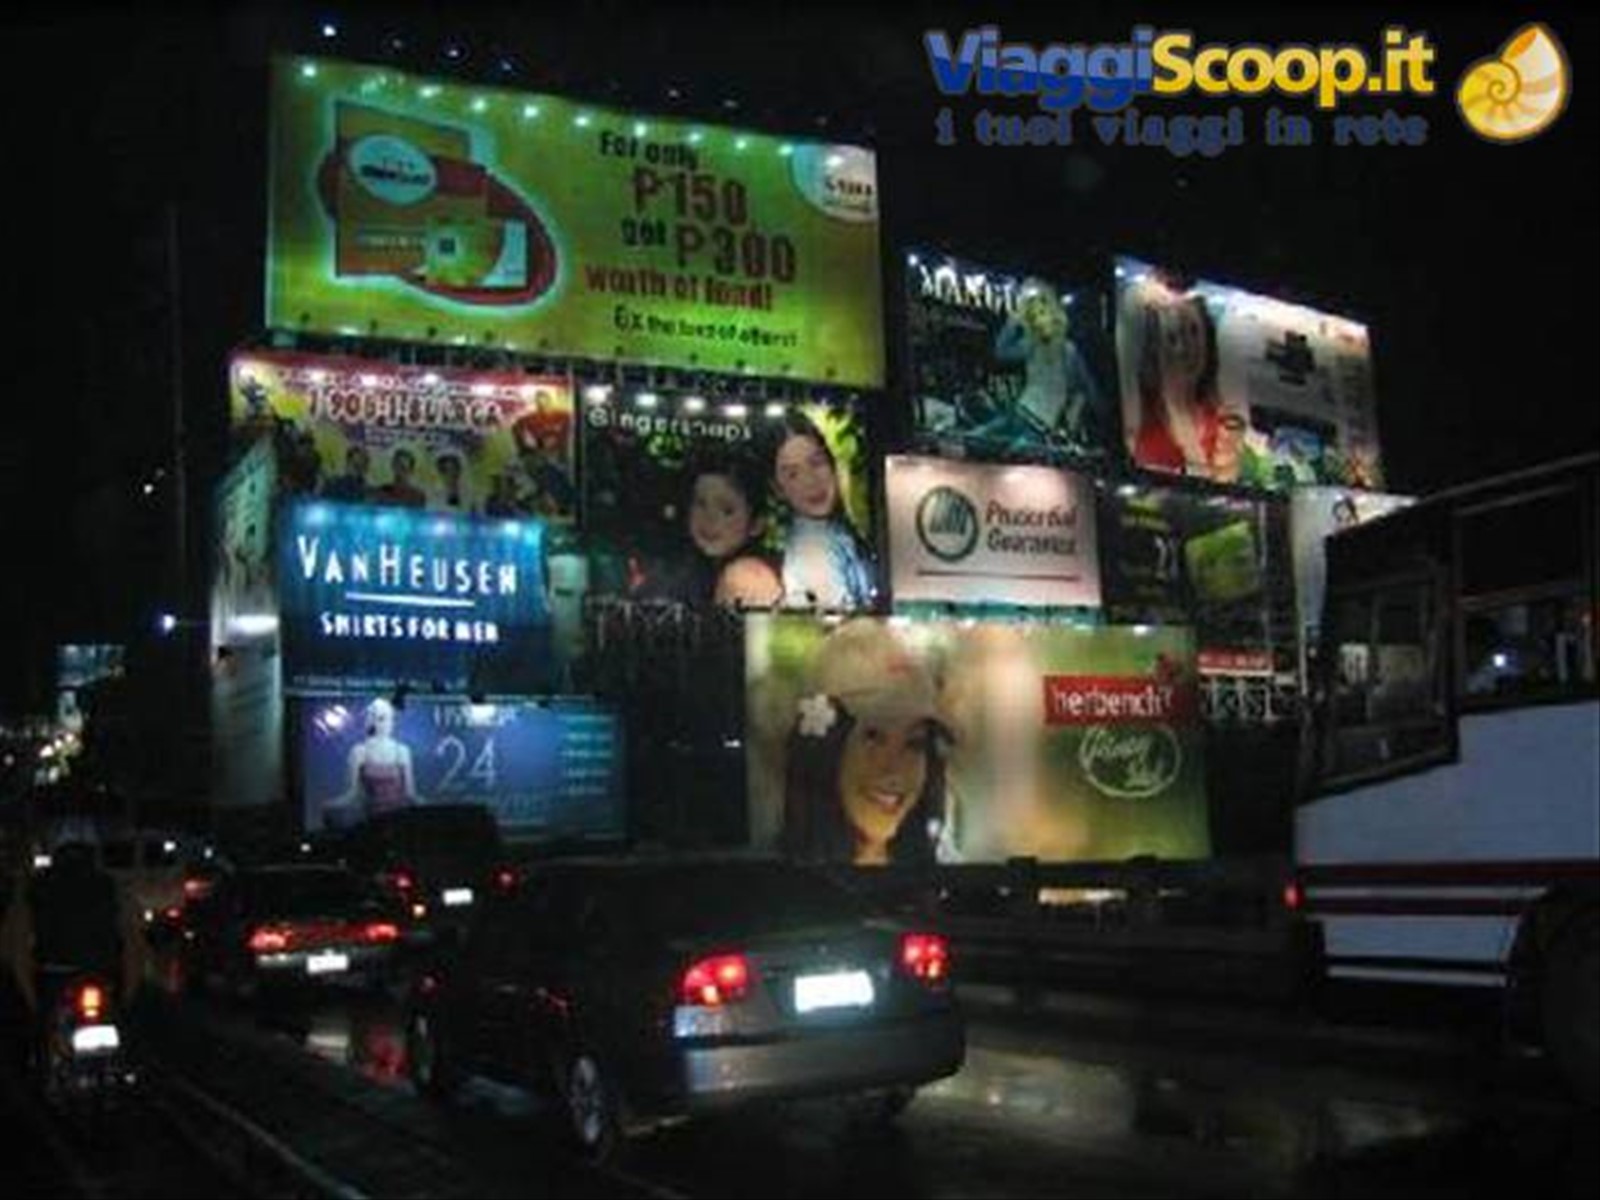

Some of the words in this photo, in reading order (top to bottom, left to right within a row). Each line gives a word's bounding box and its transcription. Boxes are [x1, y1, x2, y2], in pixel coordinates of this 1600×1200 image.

[599, 131, 639, 158] For
[675, 223, 797, 283] P300
[321, 612, 402, 637] SHIRTS
[407, 617, 449, 640] FOR
[434, 736, 497, 791] 24
